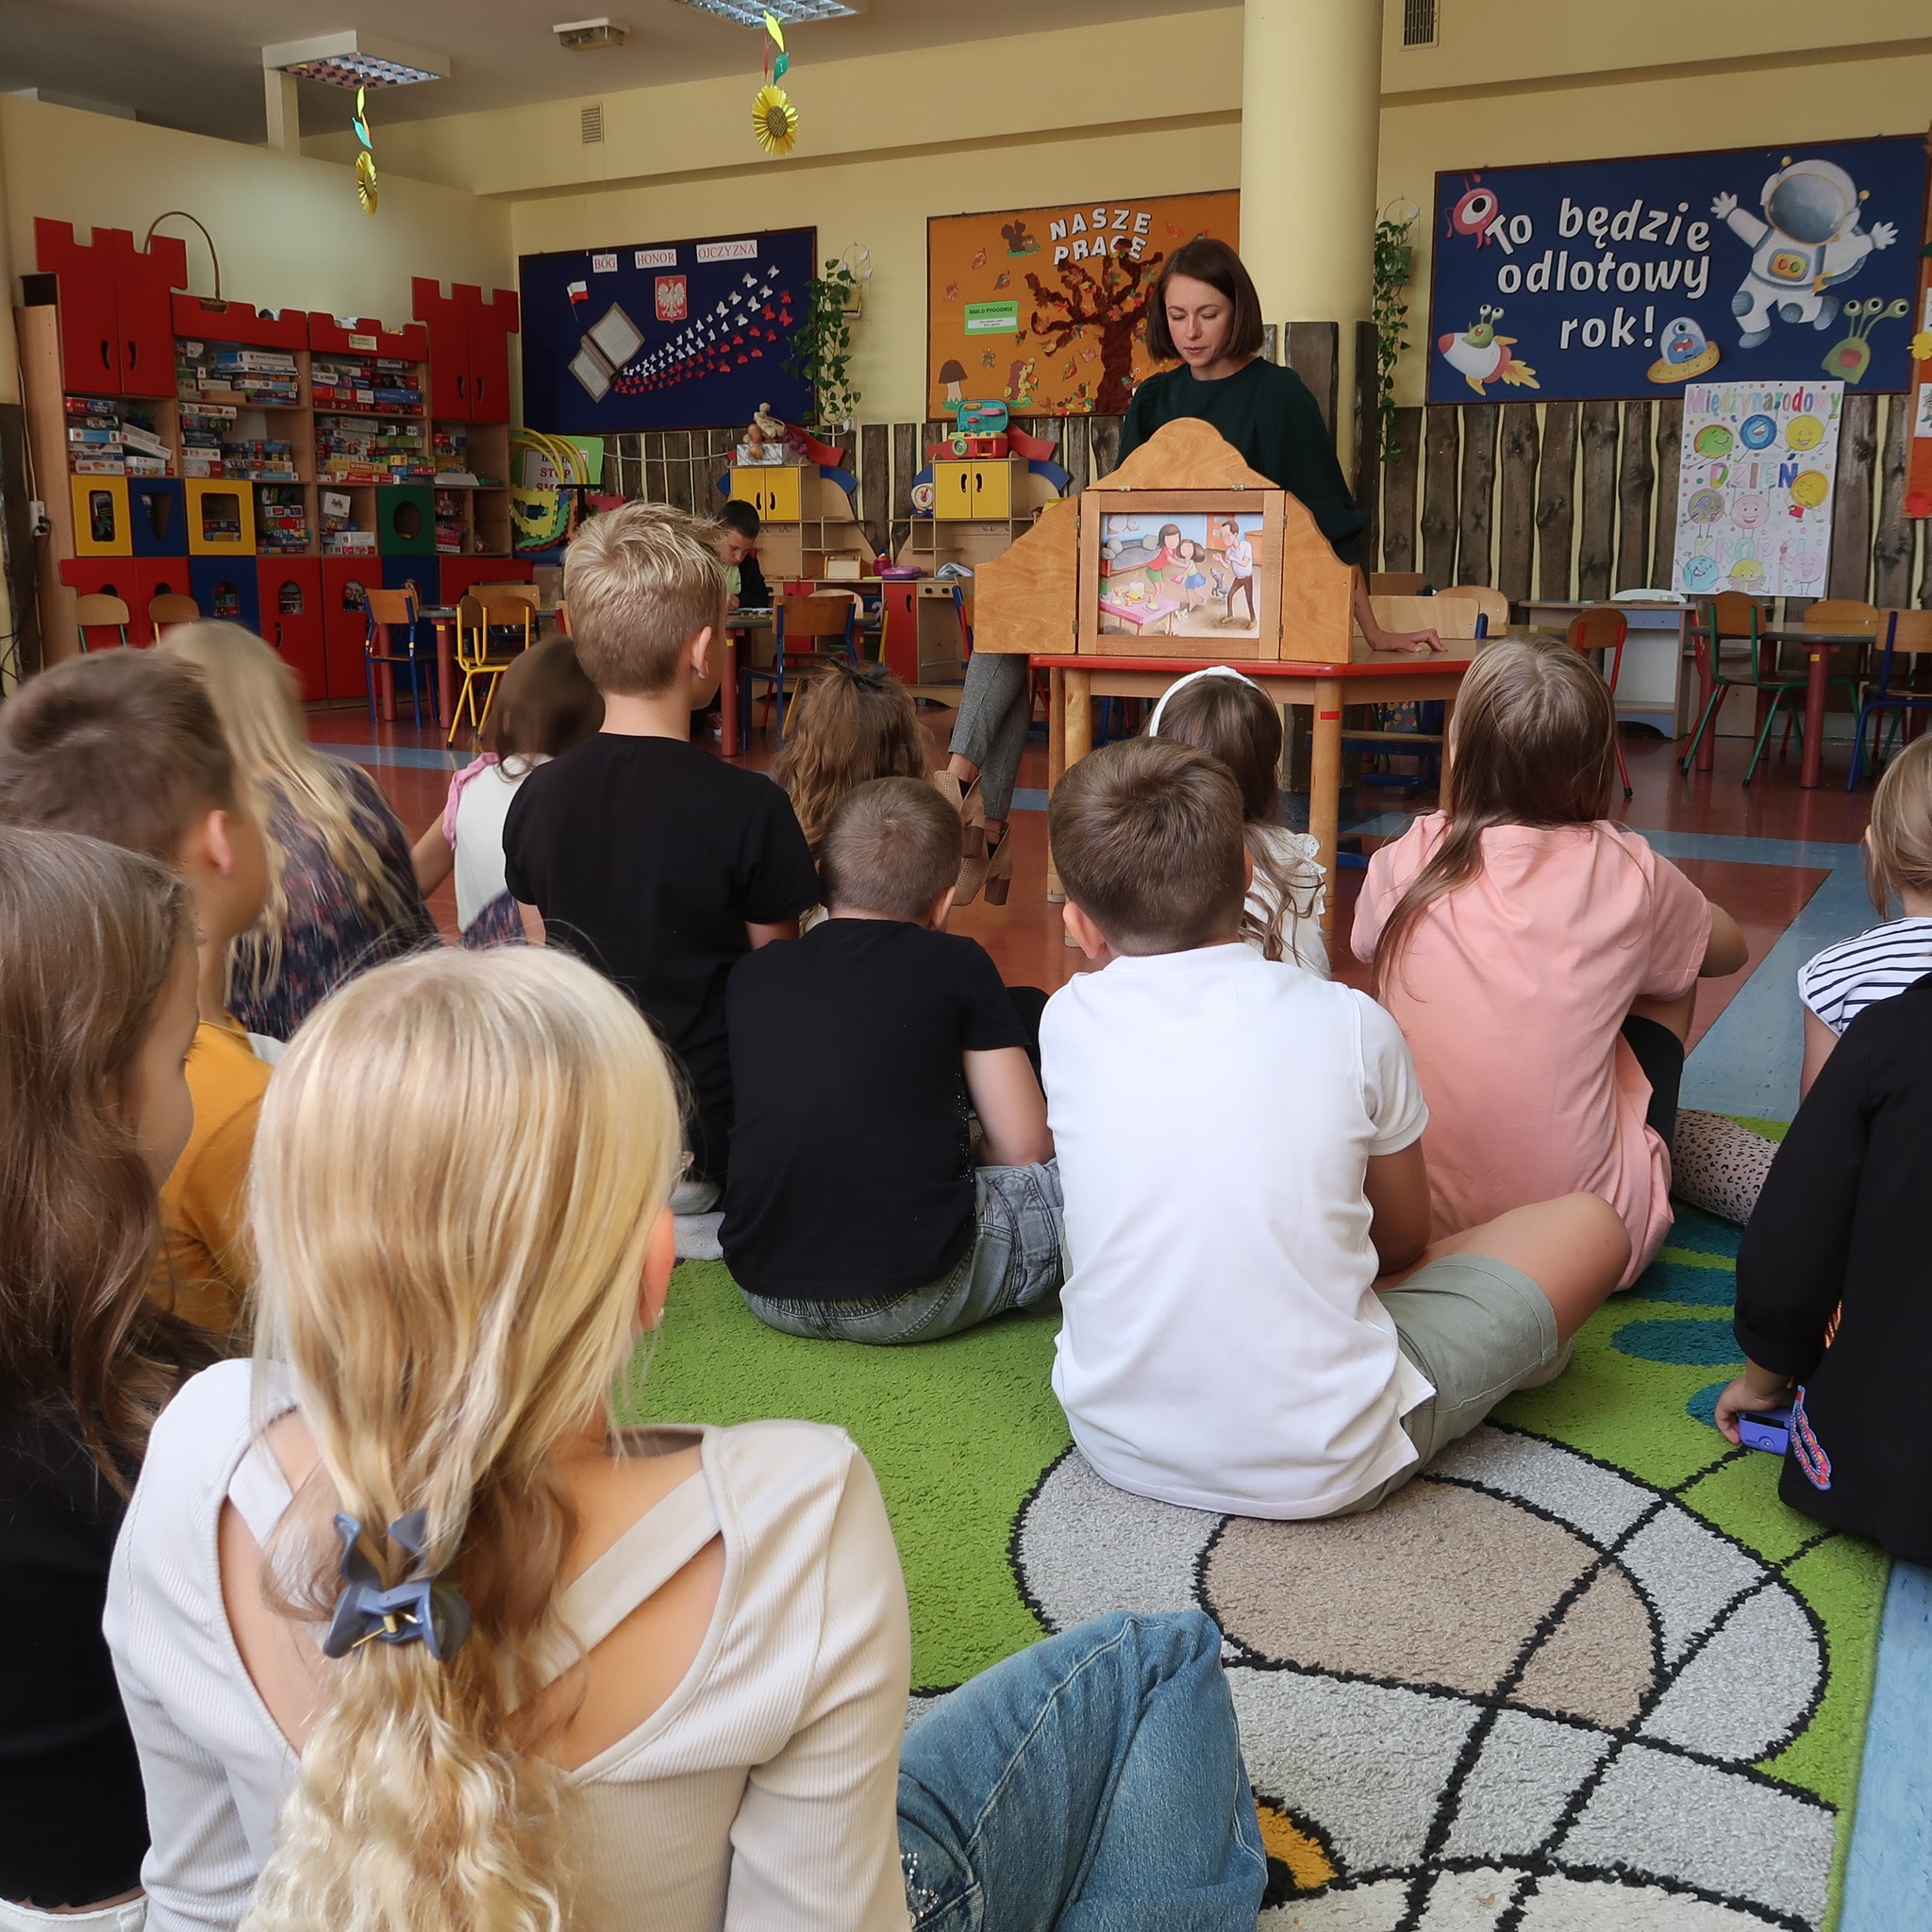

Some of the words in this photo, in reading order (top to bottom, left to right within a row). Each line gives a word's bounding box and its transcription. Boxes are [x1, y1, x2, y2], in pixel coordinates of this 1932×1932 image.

[1049, 208, 1153, 242] NASZE
[1485, 213, 1533, 255] To
[1558, 197, 1710, 252] będzie
[637, 252, 675, 266] HONOR
[698, 243, 756, 259] OJCZYZNA
[1497, 249, 1710, 299] odlotowy
[1559, 305, 1656, 349] rok!
[1685, 385, 1841, 416] Międzynarodowy
[1708, 453, 1800, 489] DZIEŃ
